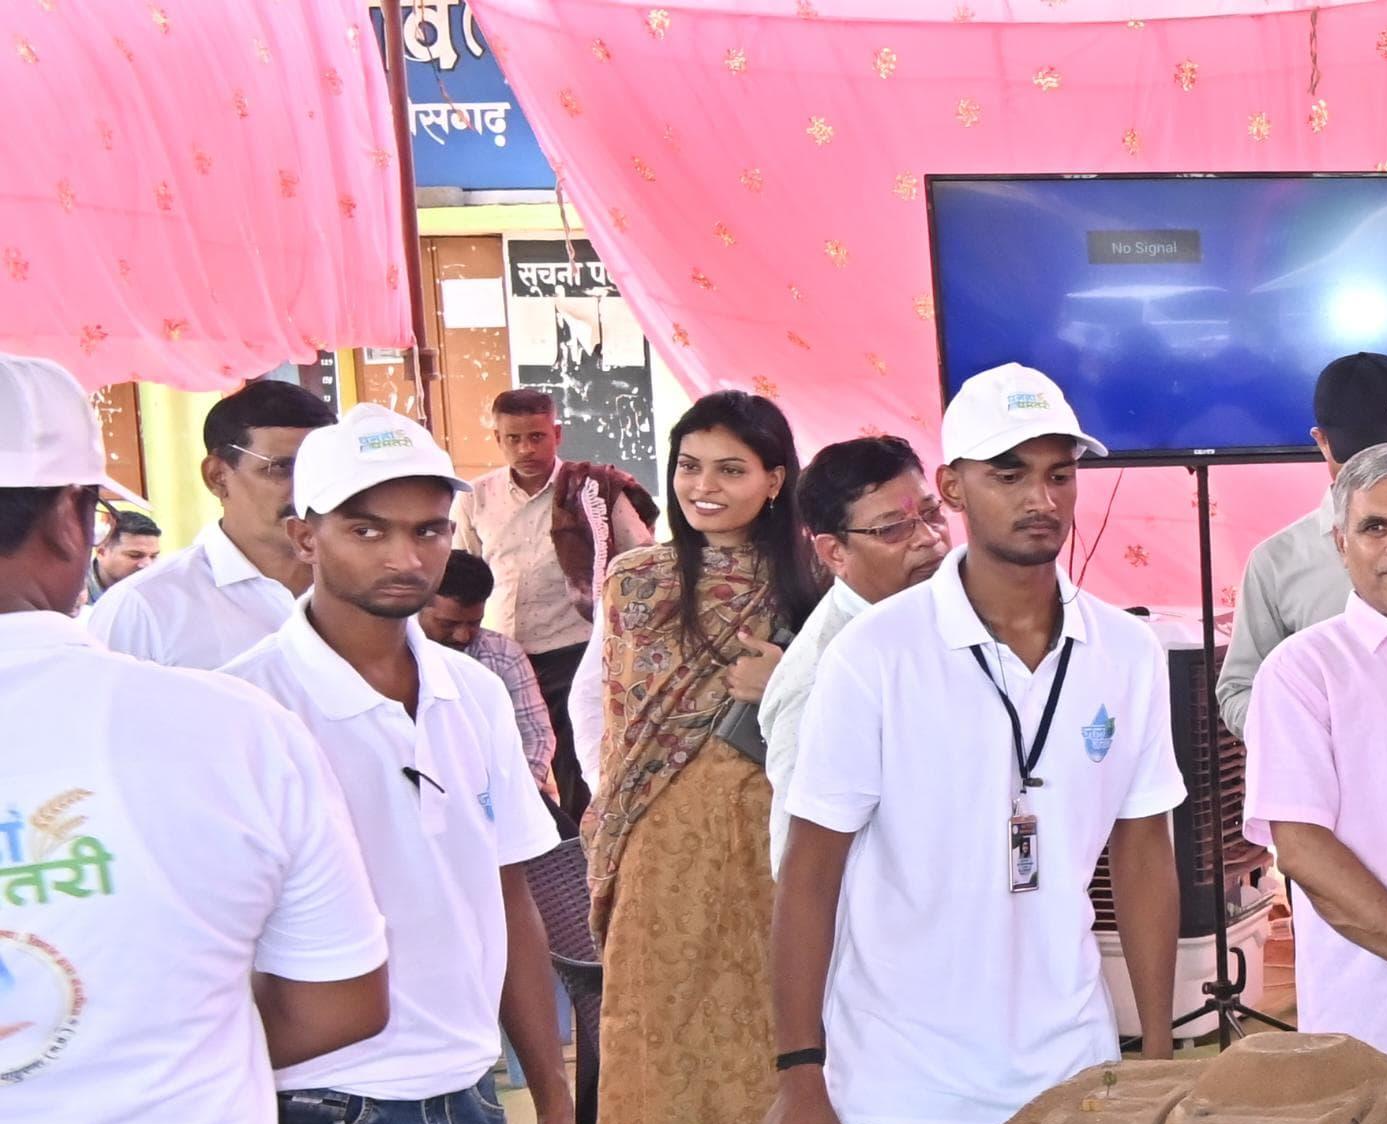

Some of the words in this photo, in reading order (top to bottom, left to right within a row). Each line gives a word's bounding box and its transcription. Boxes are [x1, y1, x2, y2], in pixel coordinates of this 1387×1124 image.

[1111, 242, 1132, 255] No
[1135, 241, 1177, 257] Signal
[516, 263, 584, 297] सूचना
